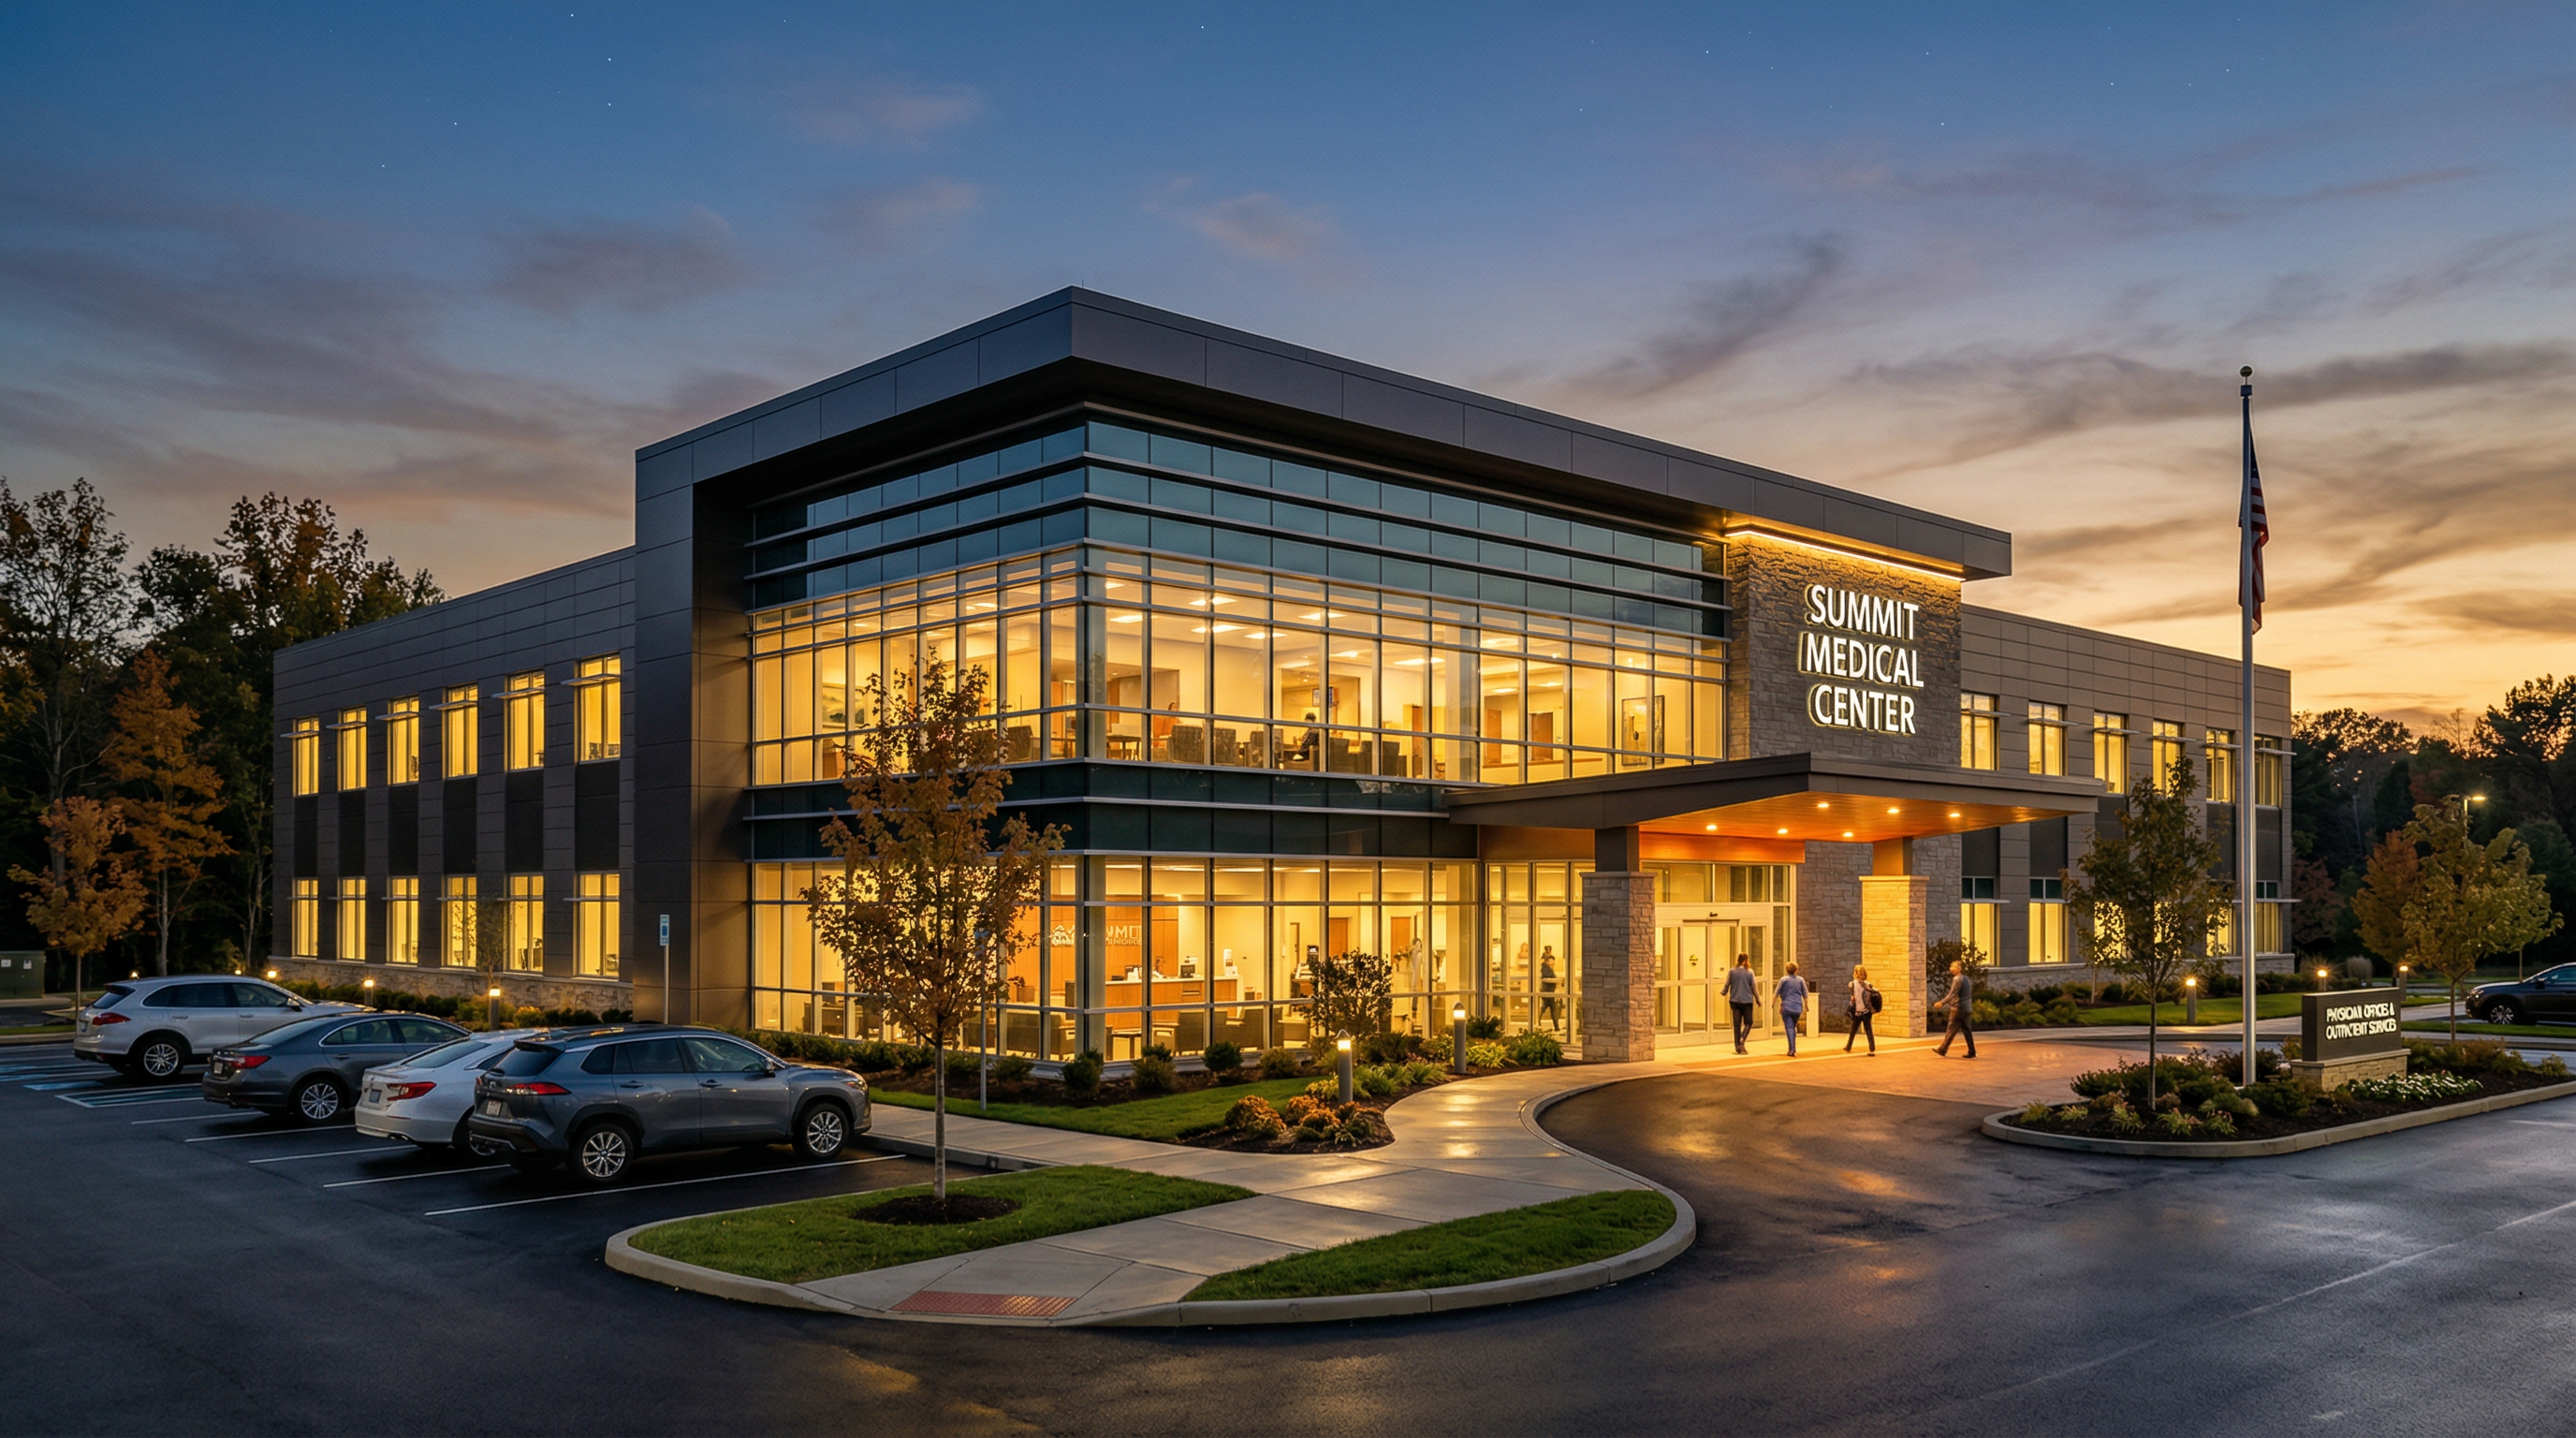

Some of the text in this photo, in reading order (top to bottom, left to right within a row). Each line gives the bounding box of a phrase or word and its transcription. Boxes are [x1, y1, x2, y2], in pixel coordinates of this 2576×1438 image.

[1808, 584, 1919, 640] SUMMIT
[1804, 632, 1925, 688] MEDICAL
[1812, 684, 1916, 735] CENTER
